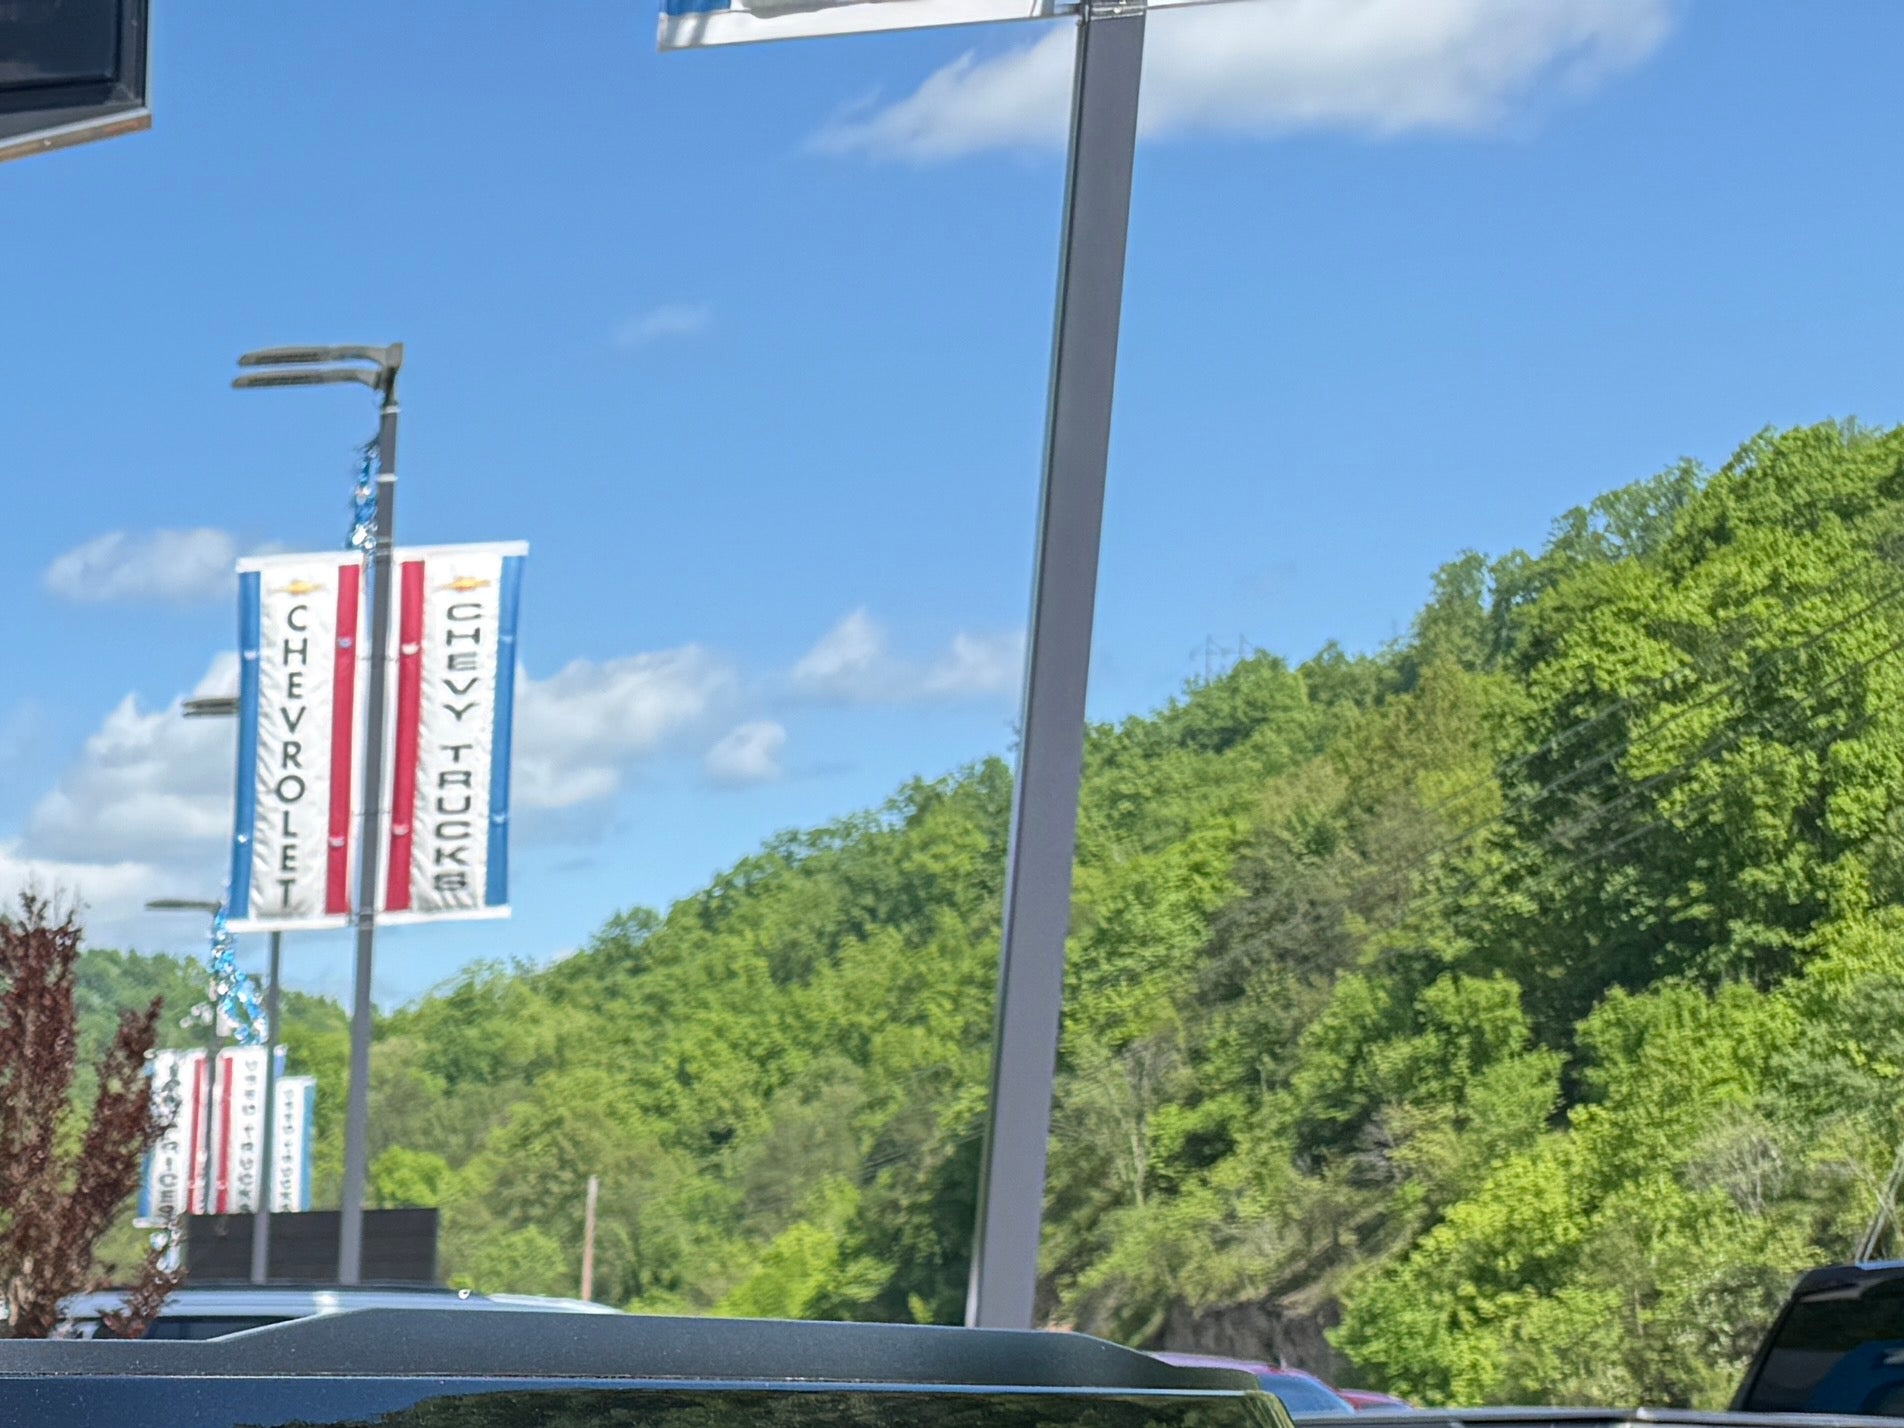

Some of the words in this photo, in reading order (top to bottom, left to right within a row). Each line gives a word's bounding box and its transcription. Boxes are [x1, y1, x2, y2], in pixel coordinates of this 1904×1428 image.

[442, 602, 482, 722] CHEVY
[276, 604, 308, 908] CHEVROLET
[433, 743, 473, 893] TRUCKS
